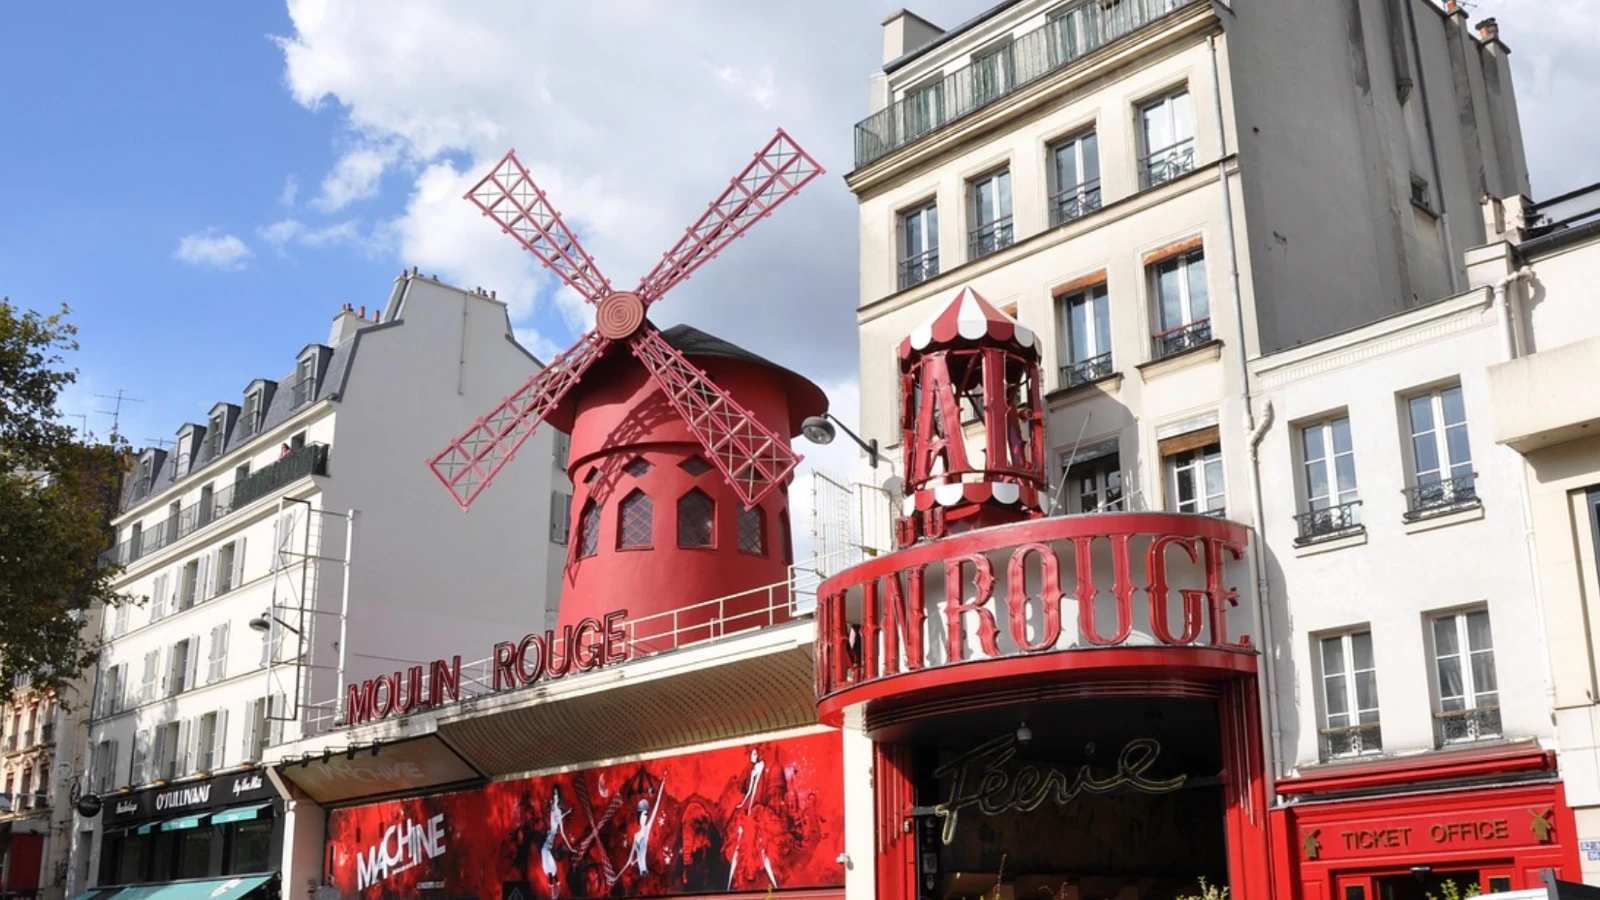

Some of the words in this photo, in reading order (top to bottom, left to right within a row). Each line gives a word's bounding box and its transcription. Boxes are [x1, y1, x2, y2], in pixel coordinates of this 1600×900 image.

[944, 533, 1253, 664] ROUGE
[346, 655, 461, 725] MOULIN
[493, 609, 628, 692] ROUGE
[356, 813, 446, 891] MACHINE
[1341, 827, 1412, 849] TICKET
[1429, 819, 1509, 843] OFFICE
